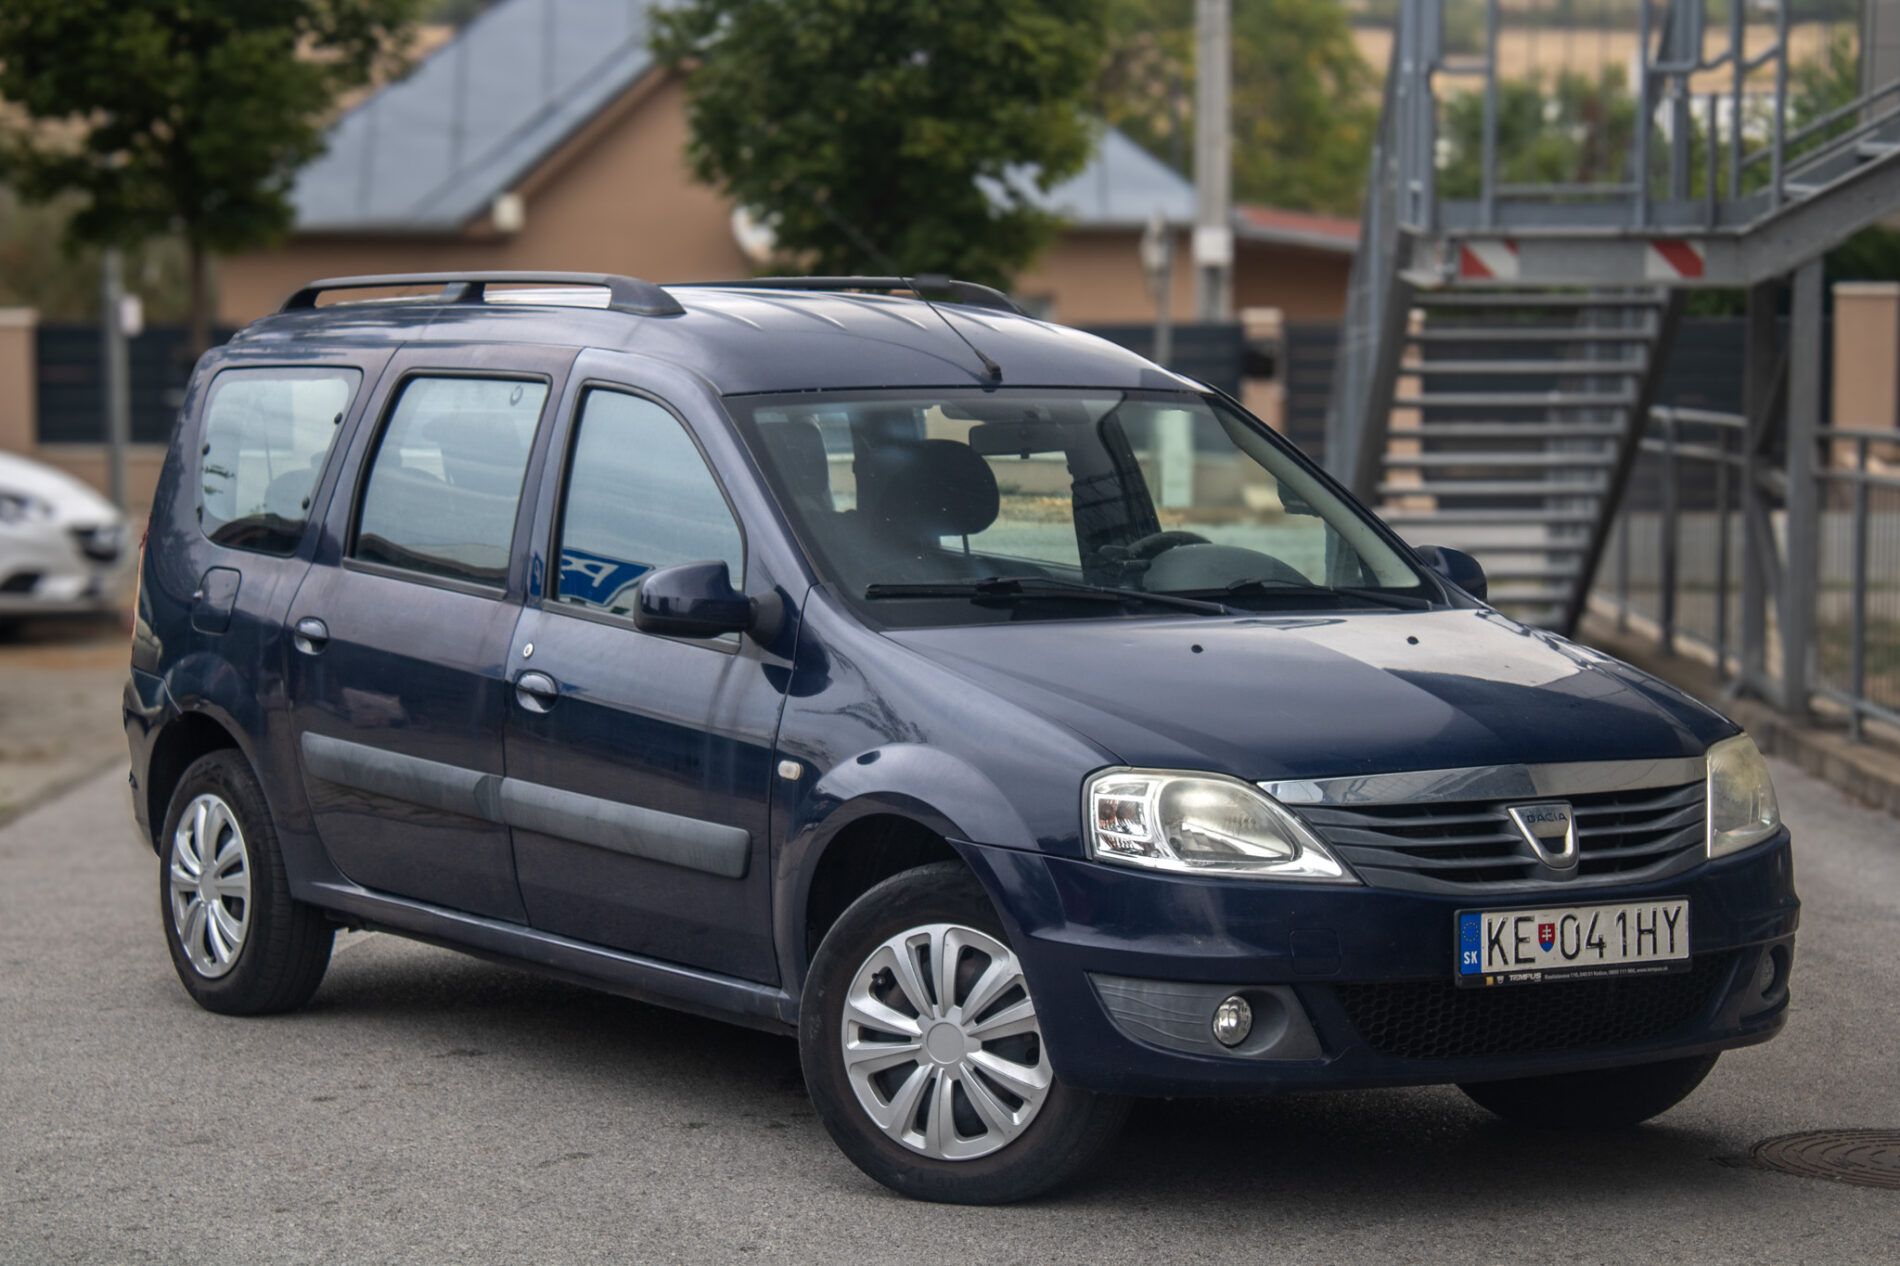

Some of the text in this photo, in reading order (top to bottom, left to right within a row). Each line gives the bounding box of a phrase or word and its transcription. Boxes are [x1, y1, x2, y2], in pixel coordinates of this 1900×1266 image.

[1526, 812, 1568, 823] DACIA
[1487, 905, 1682, 967] KE 041HY
[1463, 950, 1478, 965] SK
